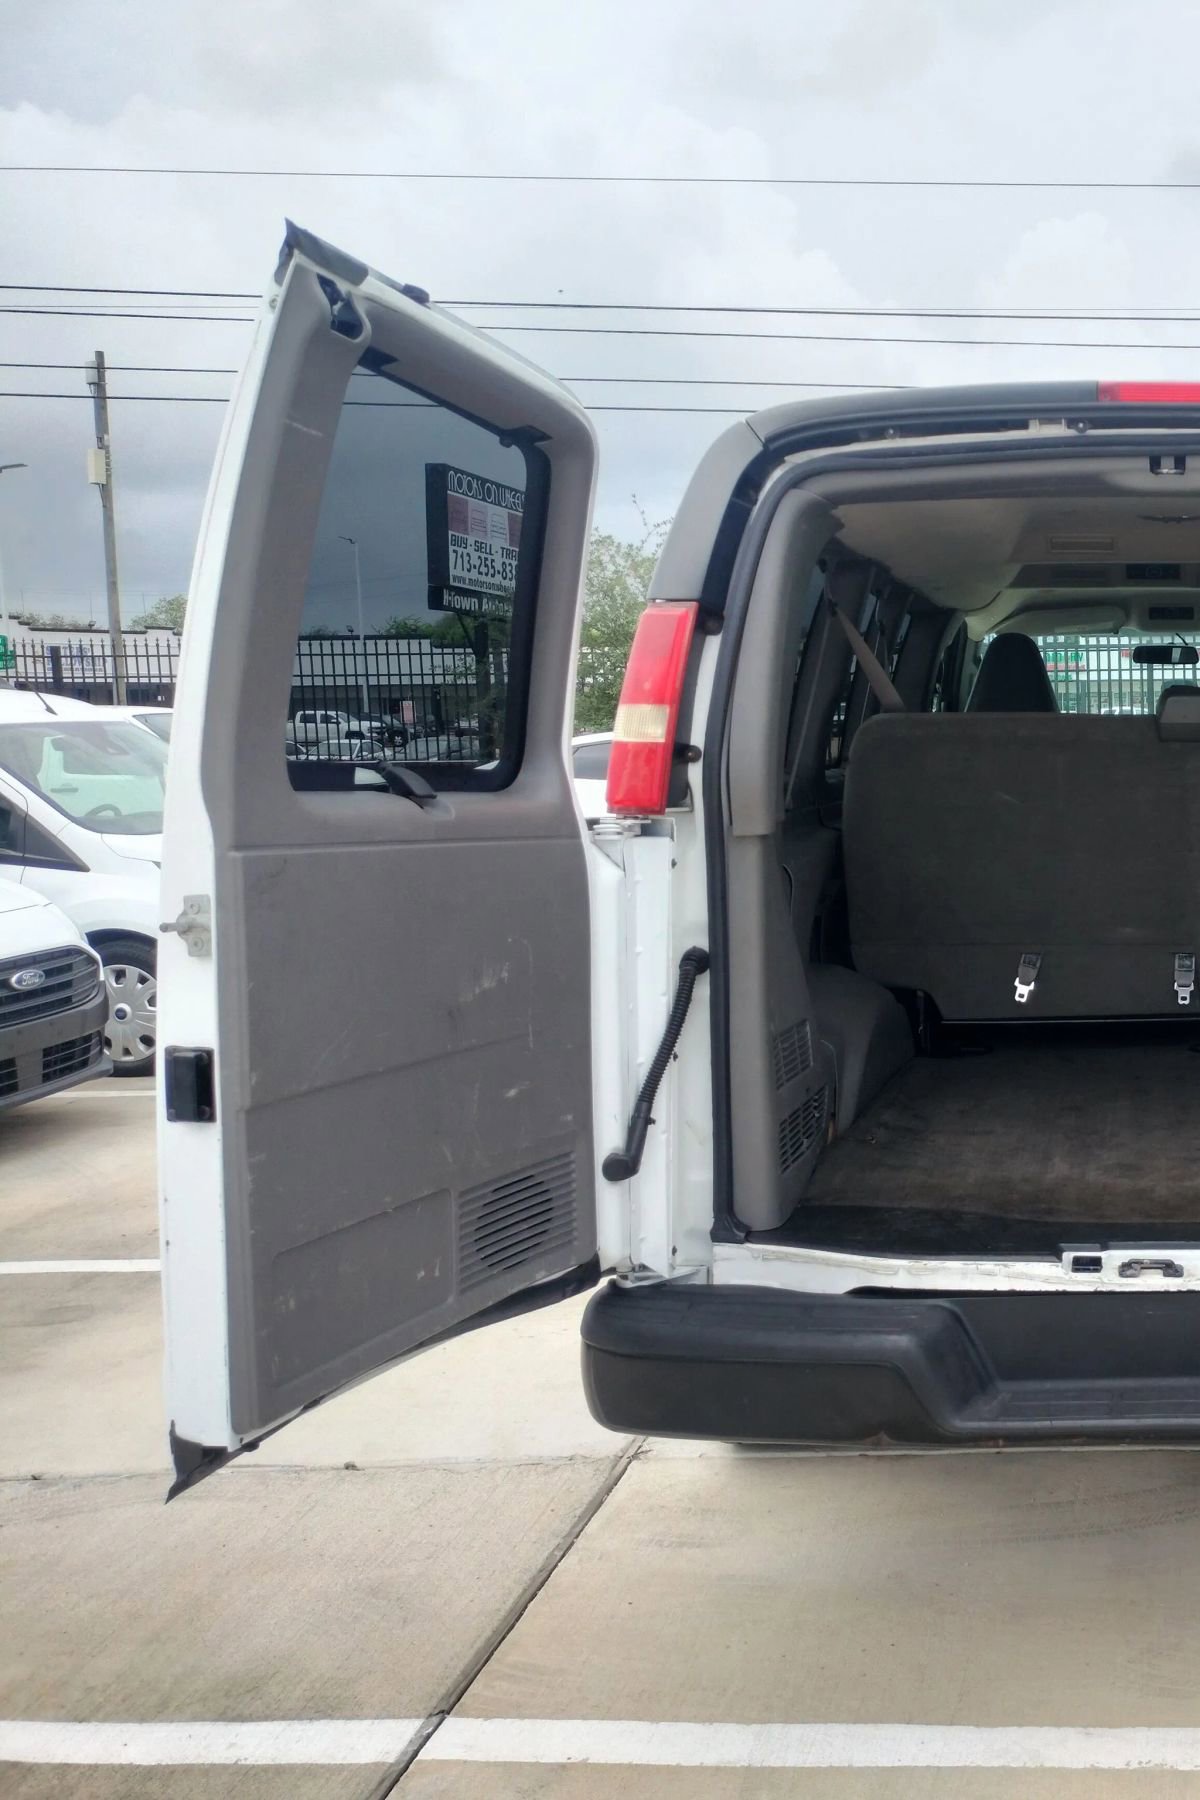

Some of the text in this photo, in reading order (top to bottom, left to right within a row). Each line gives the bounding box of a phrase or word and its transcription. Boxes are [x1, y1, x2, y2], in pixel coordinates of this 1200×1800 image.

[448, 470, 483, 499] MOTORS
[484, 482, 499, 505] ON
[450, 534, 518, 561] BUY SELL TRA
[452, 549, 517, 582] 713-255-83
[22, 972, 39, 985] Ford
